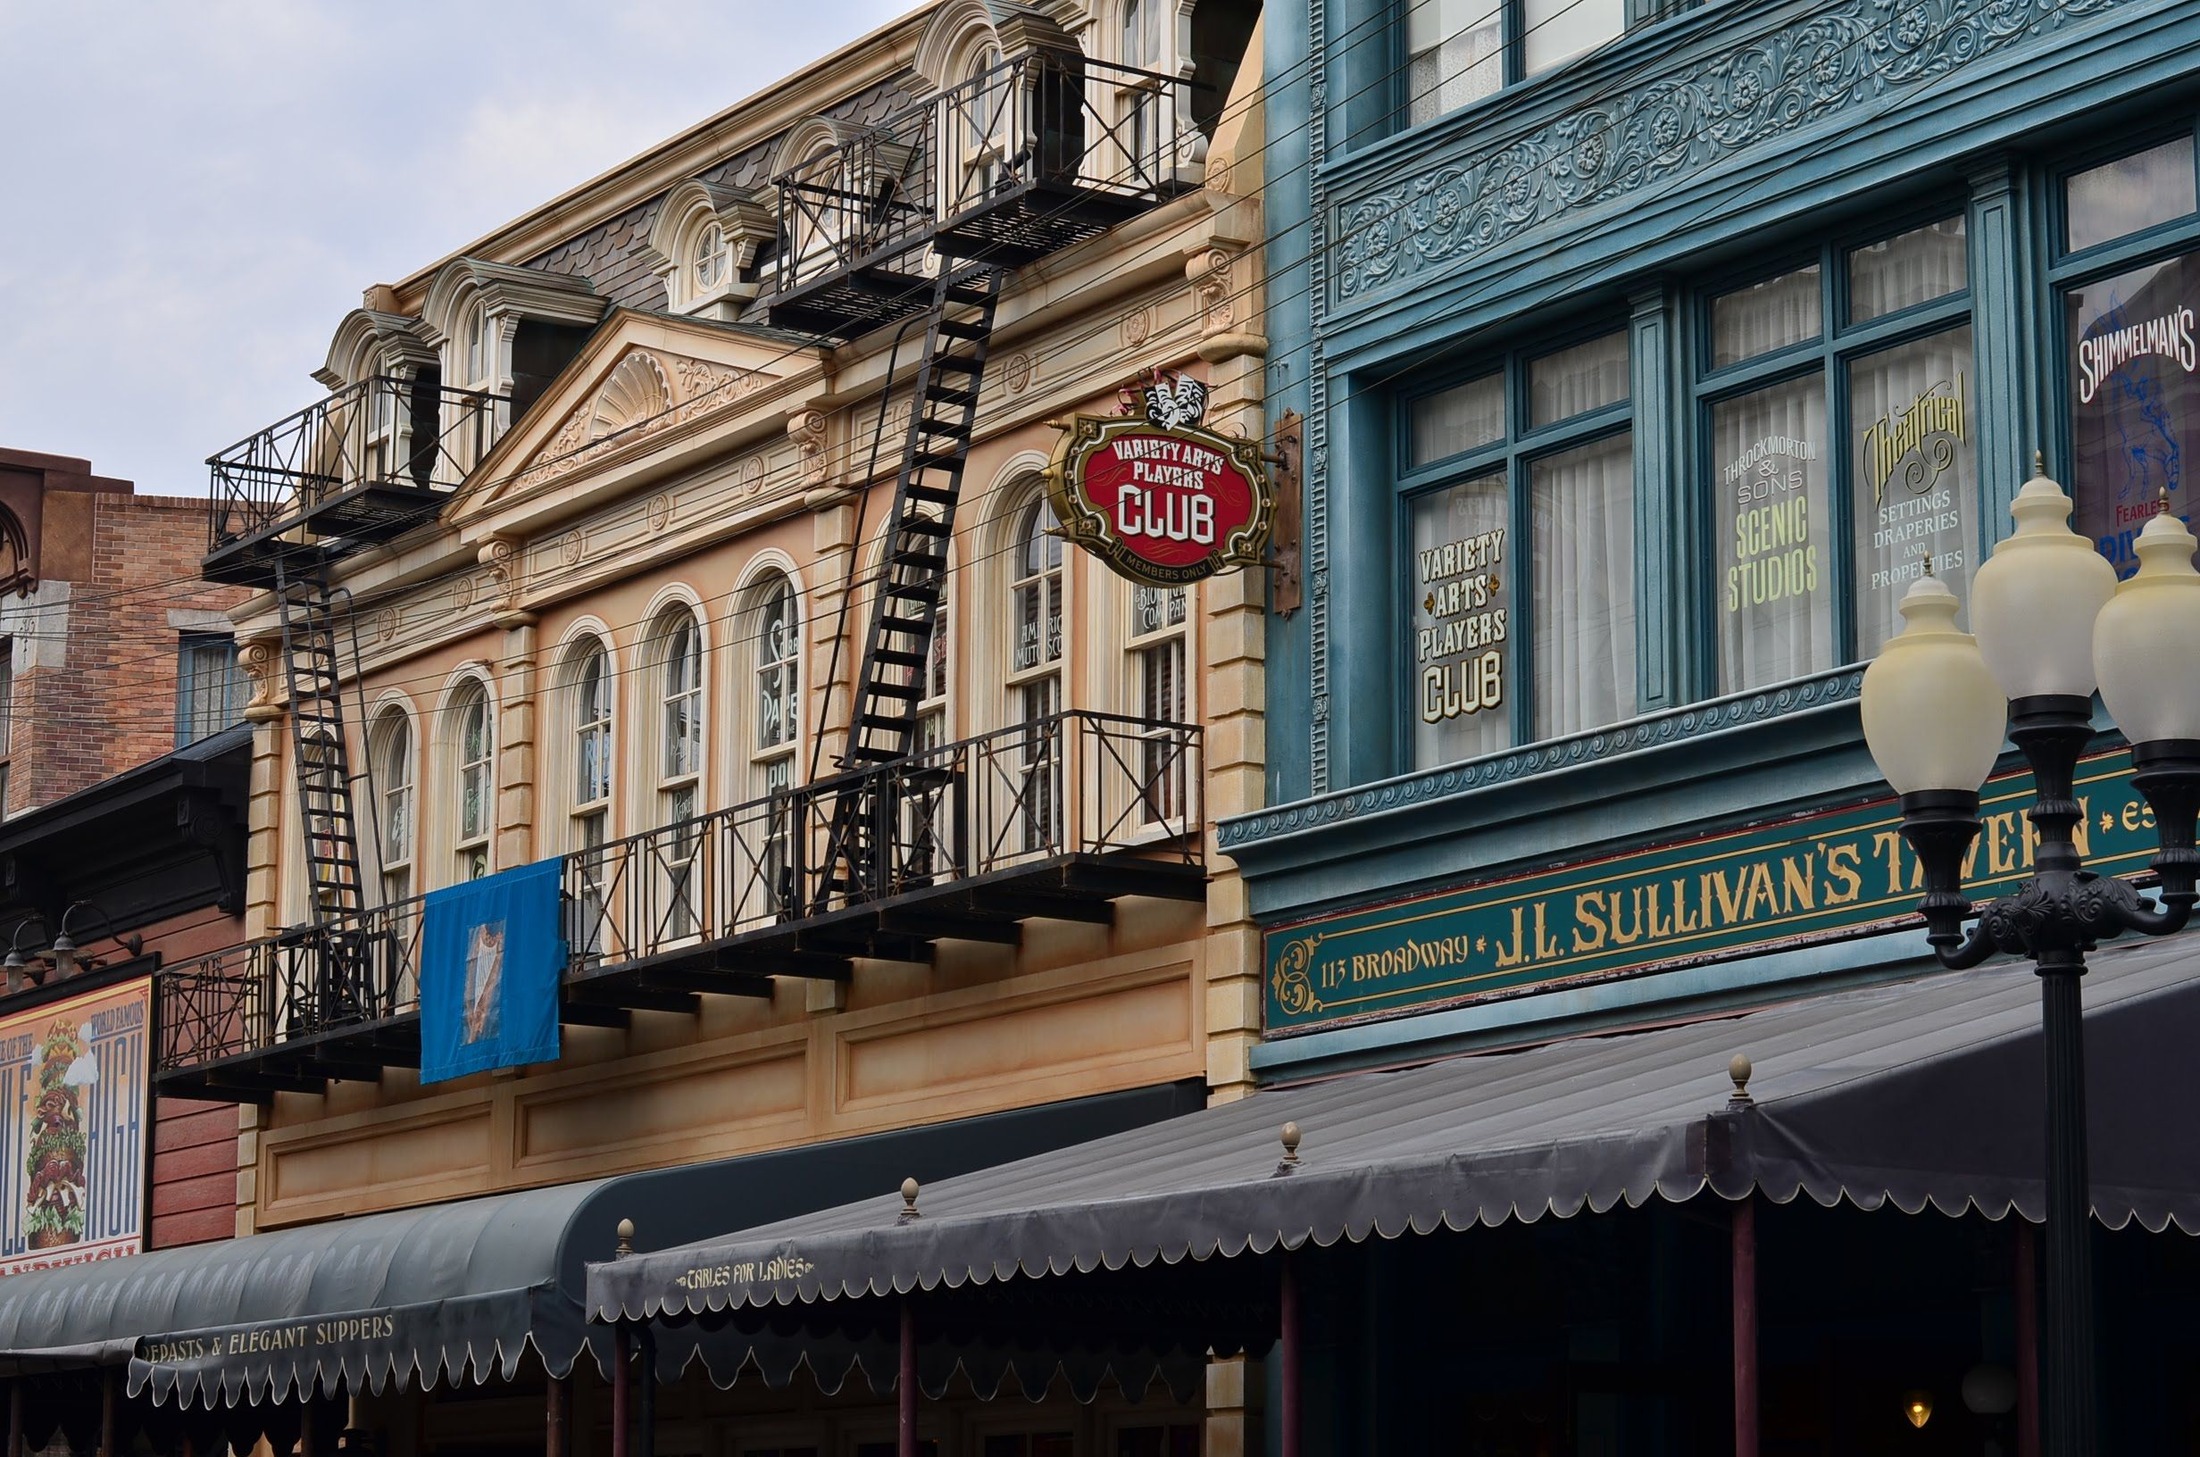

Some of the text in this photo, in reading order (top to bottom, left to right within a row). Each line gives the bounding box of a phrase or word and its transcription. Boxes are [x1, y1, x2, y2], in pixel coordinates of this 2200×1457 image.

[2079, 304, 2196, 404] SHIMMELMAN'S
[1112, 439, 1224, 476] VARIETY ARTS
[1723, 436, 1816, 486] THROCKMORTON
[1863, 371, 1966, 512] Theatrical
[1133, 461, 1204, 491] PLAYERS
[1737, 470, 1803, 504] SONS
[1759, 459, 1779, 477] &
[1118, 484, 1215, 545] CLUB
[1736, 496, 1807, 559] SCENIC
[1873, 510, 1958, 549] DRAPERIES
[1879, 490, 1951, 525] SETTINGS
[1126, 555, 1208, 580] MEMBERS ONLY
[1419, 528, 1504, 584] VARIETY
[1903, 542, 1926, 559] AND
[1435, 573, 1488, 619] ARTS
[1728, 544, 1818, 612] STUDIOS
[1418, 608, 1506, 663] PLAYERS
[1422, 650, 1502, 724] CLUB
[1352, 935, 1469, 982] BROADWAY
[1495, 902, 1564, 968] J.L.
[1572, 842, 1862, 952] SULLIVAN'S
[84, 1032, 143, 1242] HIGH
[687, 1255, 804, 1290] TABLES FOR LADIES
[211, 1336, 222, 1356] &
[229, 1325, 308, 1355] ELEGANT
[316, 1314, 394, 1346] SUPPERS
